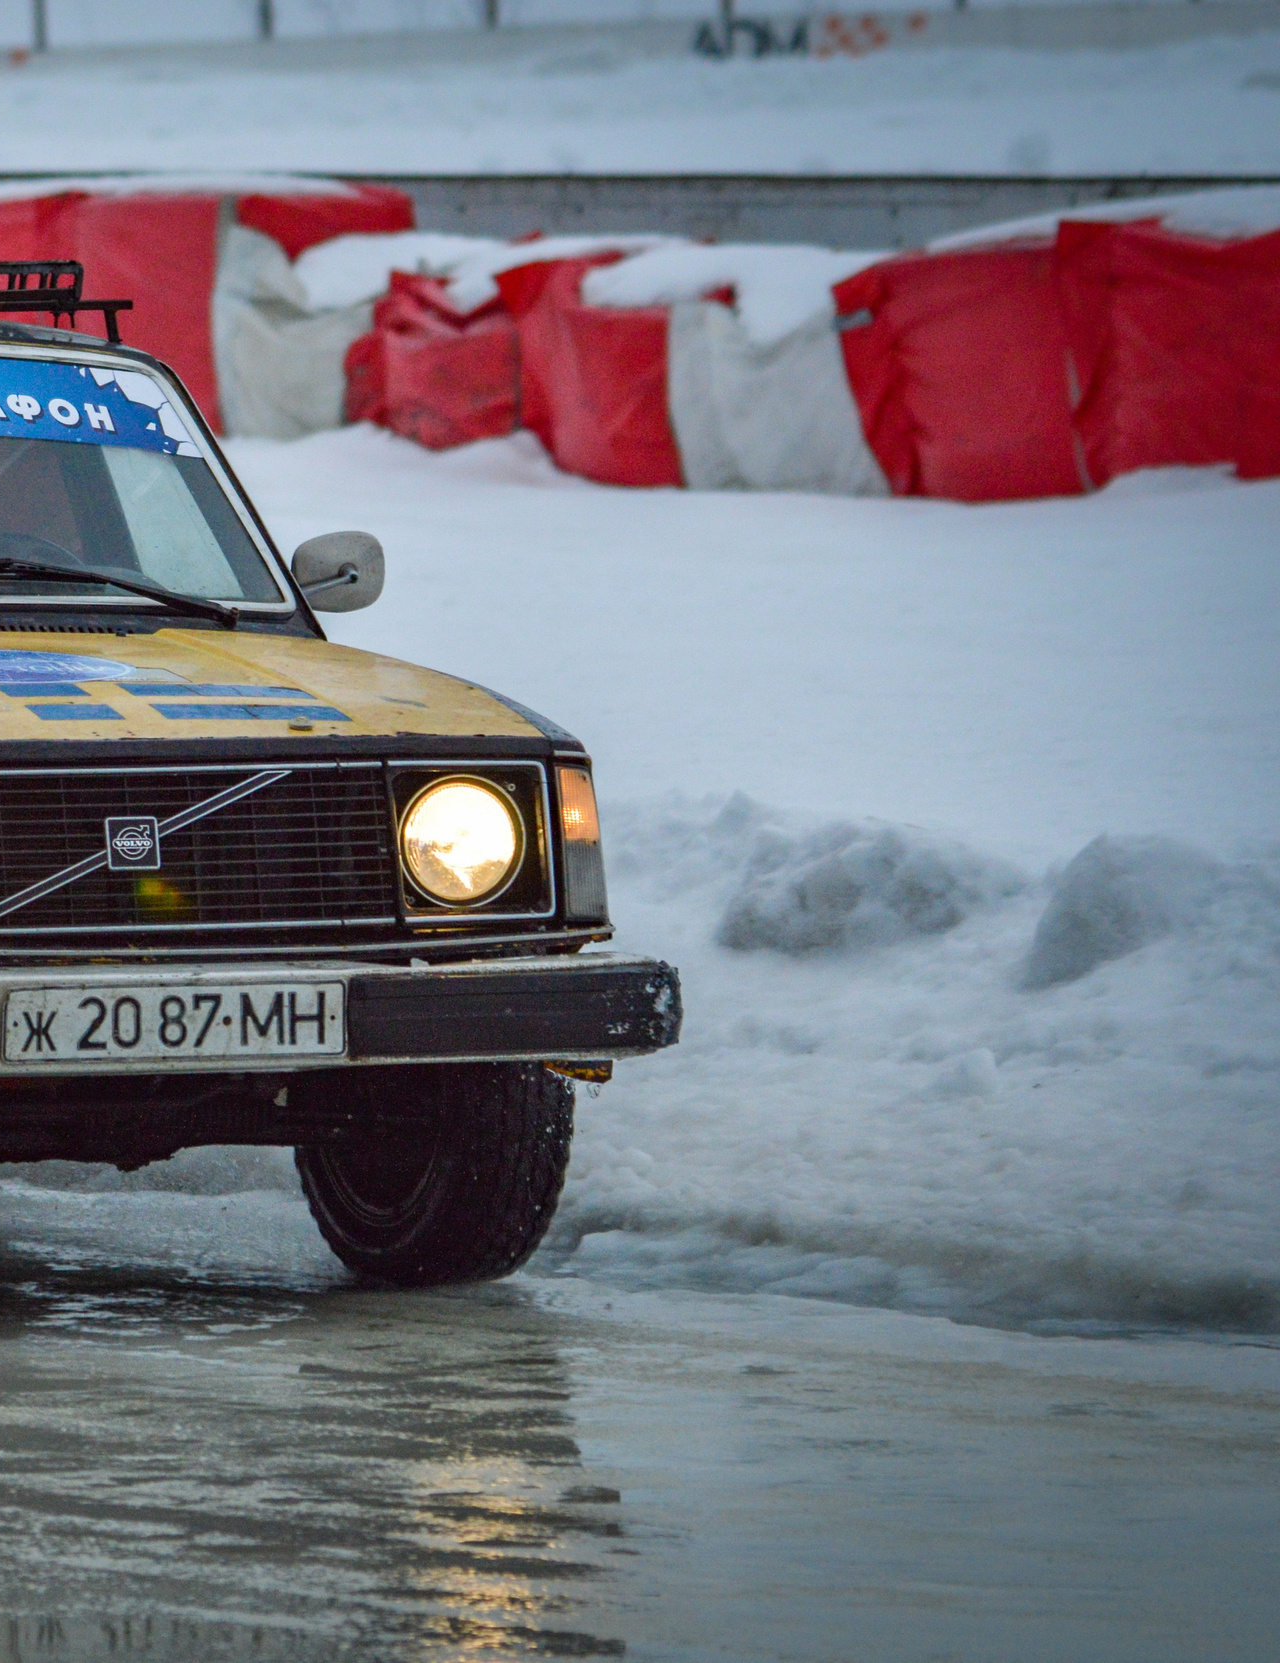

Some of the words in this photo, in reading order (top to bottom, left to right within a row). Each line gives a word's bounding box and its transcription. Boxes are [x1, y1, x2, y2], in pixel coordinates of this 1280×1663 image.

[22, 1010, 56, 1052] Ж
[76, 995, 141, 1050] 20
[158, 993, 223, 1048] 87
[239, 990, 326, 1046] МН
